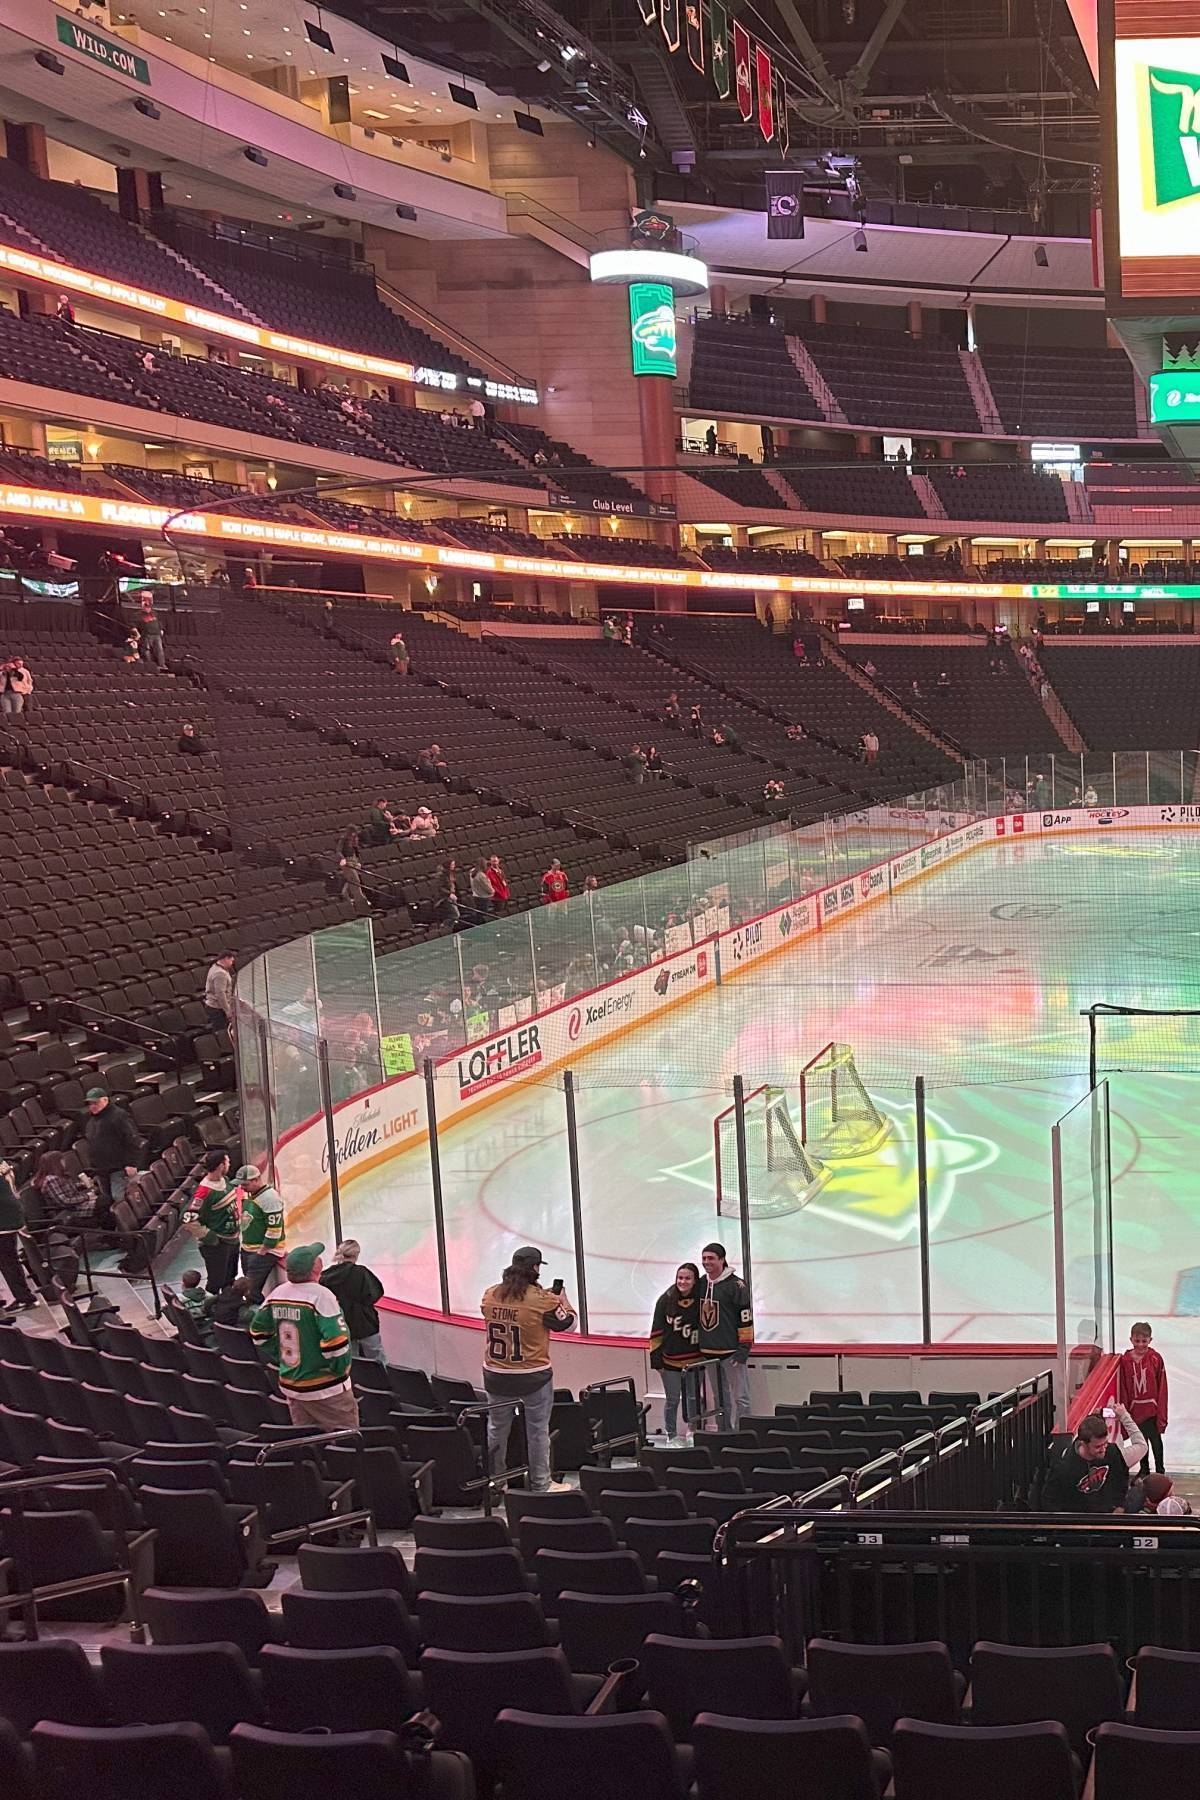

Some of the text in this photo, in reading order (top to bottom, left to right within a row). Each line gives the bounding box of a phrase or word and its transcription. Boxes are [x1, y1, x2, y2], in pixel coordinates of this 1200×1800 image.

[73, 26, 137, 76] WILD.COM
[593, 499, 634, 513] Club Level
[746, 922, 762, 947] PILOT
[672, 967, 690, 983] STREAM
[586, 992, 633, 1025] Xcel Energy
[458, 1025, 541, 1087] LOFFLER
[322, 1109, 418, 1173] Golden LIGHT
[183, 1212, 199, 1223] 97
[268, 1214, 281, 1225] 97
[492, 1307, 518, 1322] STONE
[666, 1314, 699, 1345] VEGA
[488, 1321, 524, 1363] 61
[1132, 1361, 1148, 1399] M
